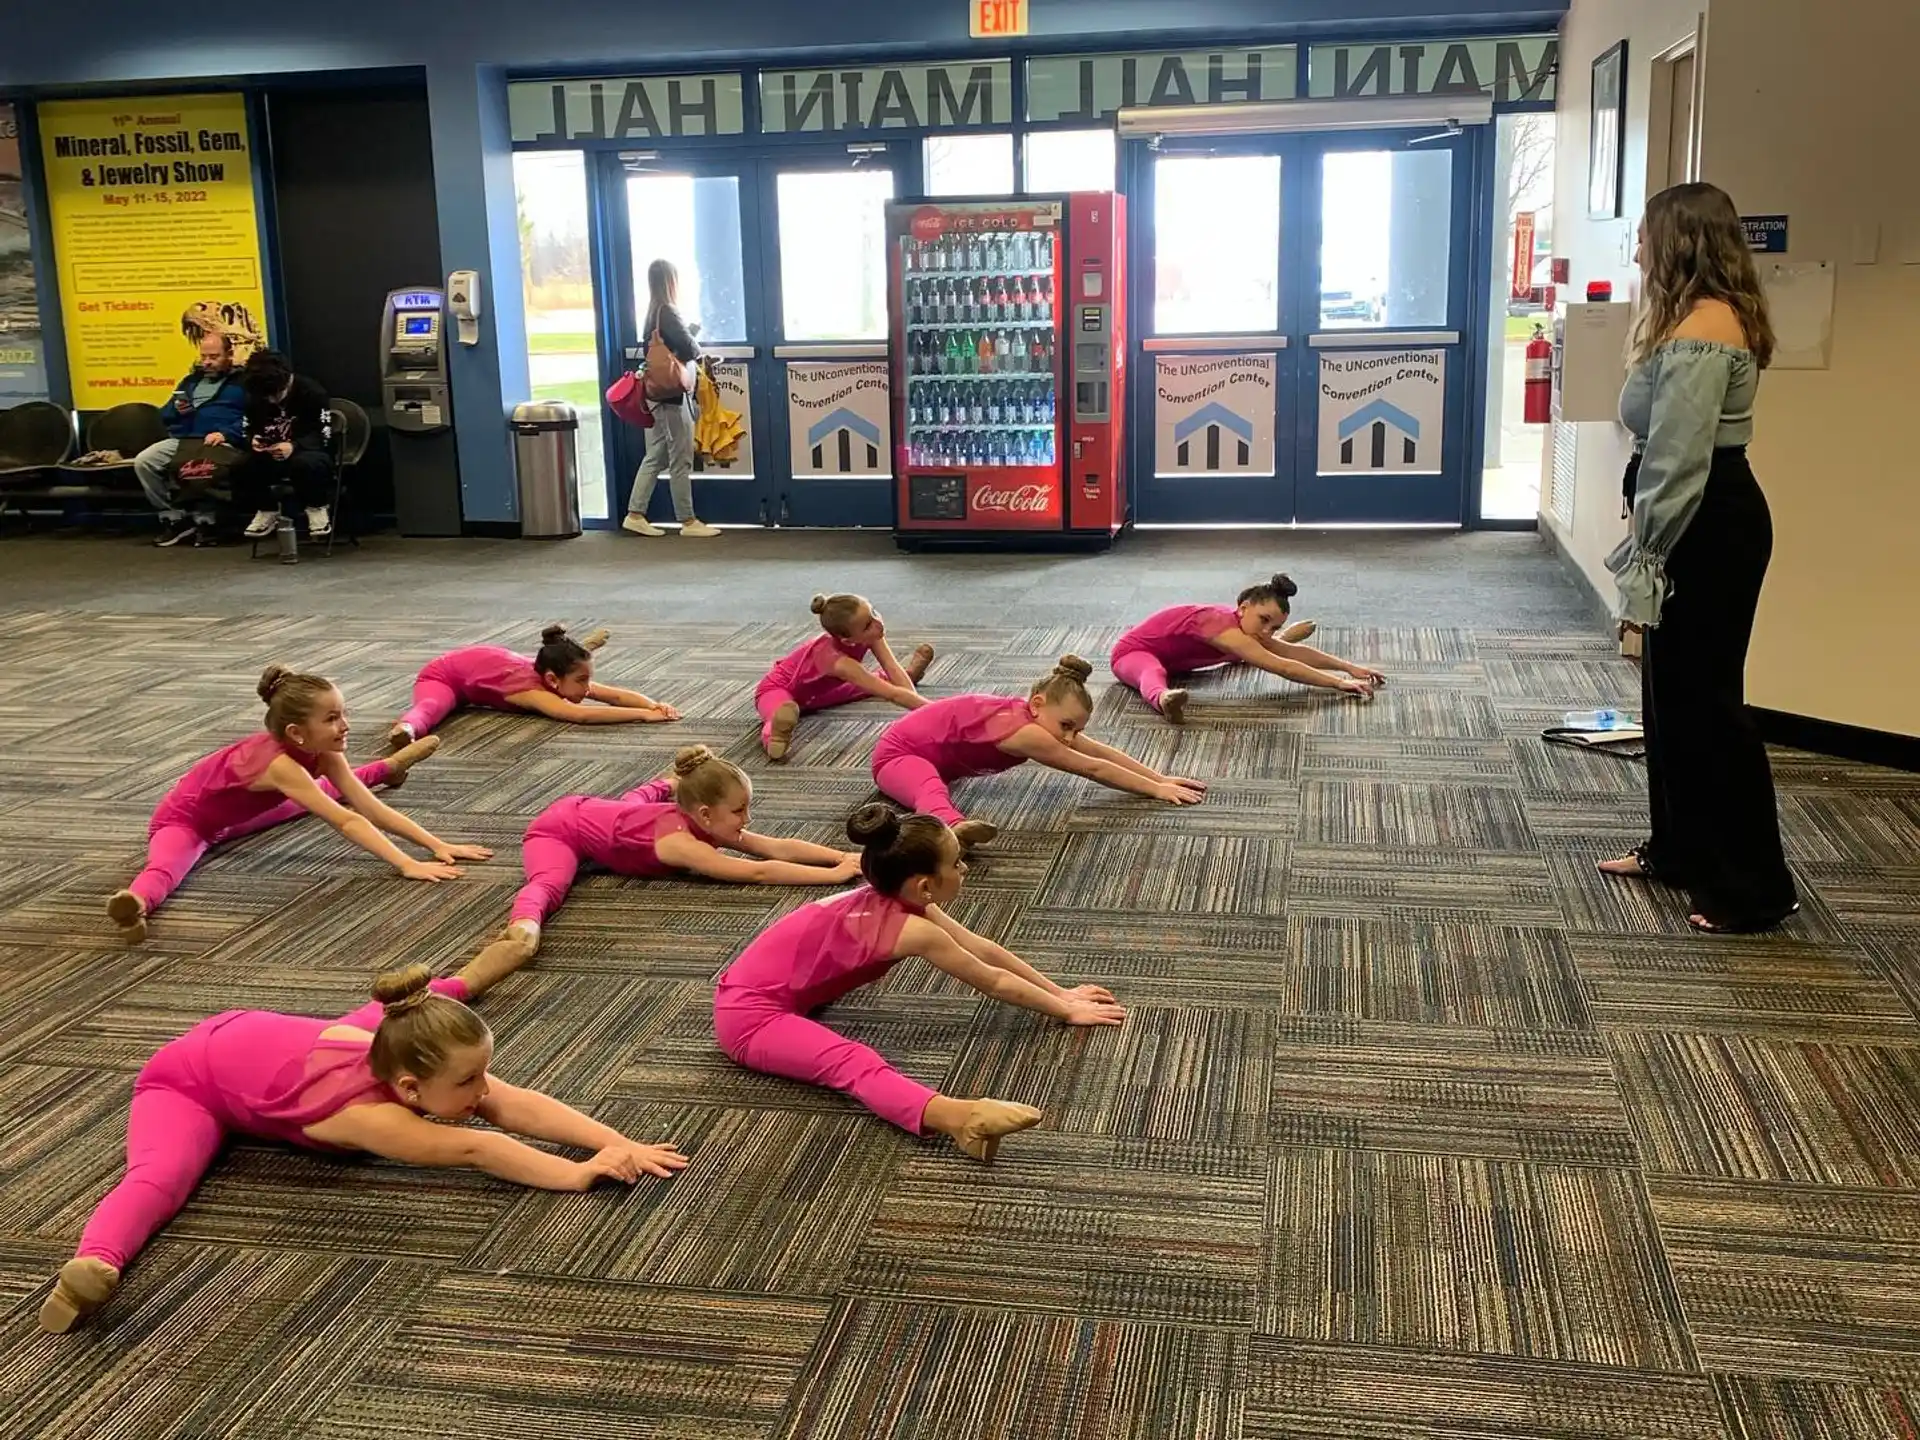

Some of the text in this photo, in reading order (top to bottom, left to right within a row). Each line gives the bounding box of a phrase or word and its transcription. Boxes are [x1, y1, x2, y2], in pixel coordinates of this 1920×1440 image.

[980, 0, 1020, 33] EXIT
[137, 113, 181, 126] Annual
[54, 129, 246, 157] Mineral, Fossil, Gem,
[81, 161, 224, 186] & Jewelry Show
[103, 194, 129, 206] May
[176, 191, 208, 203] 2022
[953, 217, 976, 229] ICE
[982, 215, 1018, 228] COLD
[1740, 220, 1786, 231] STRATION
[78, 300, 155, 312] Get Tickets:
[1158, 356, 1270, 376] The UNconventional
[1321, 351, 1439, 372] The UNconventional
[789, 363, 889, 382] The UNconventiona
[715, 380, 745, 395] enter
[790, 379, 889, 409] Convention Cente
[1158, 372, 1271, 404] Convention Center
[1321, 369, 1440, 400] Convention Center
[972, 484, 1054, 512] Coca-Cola
